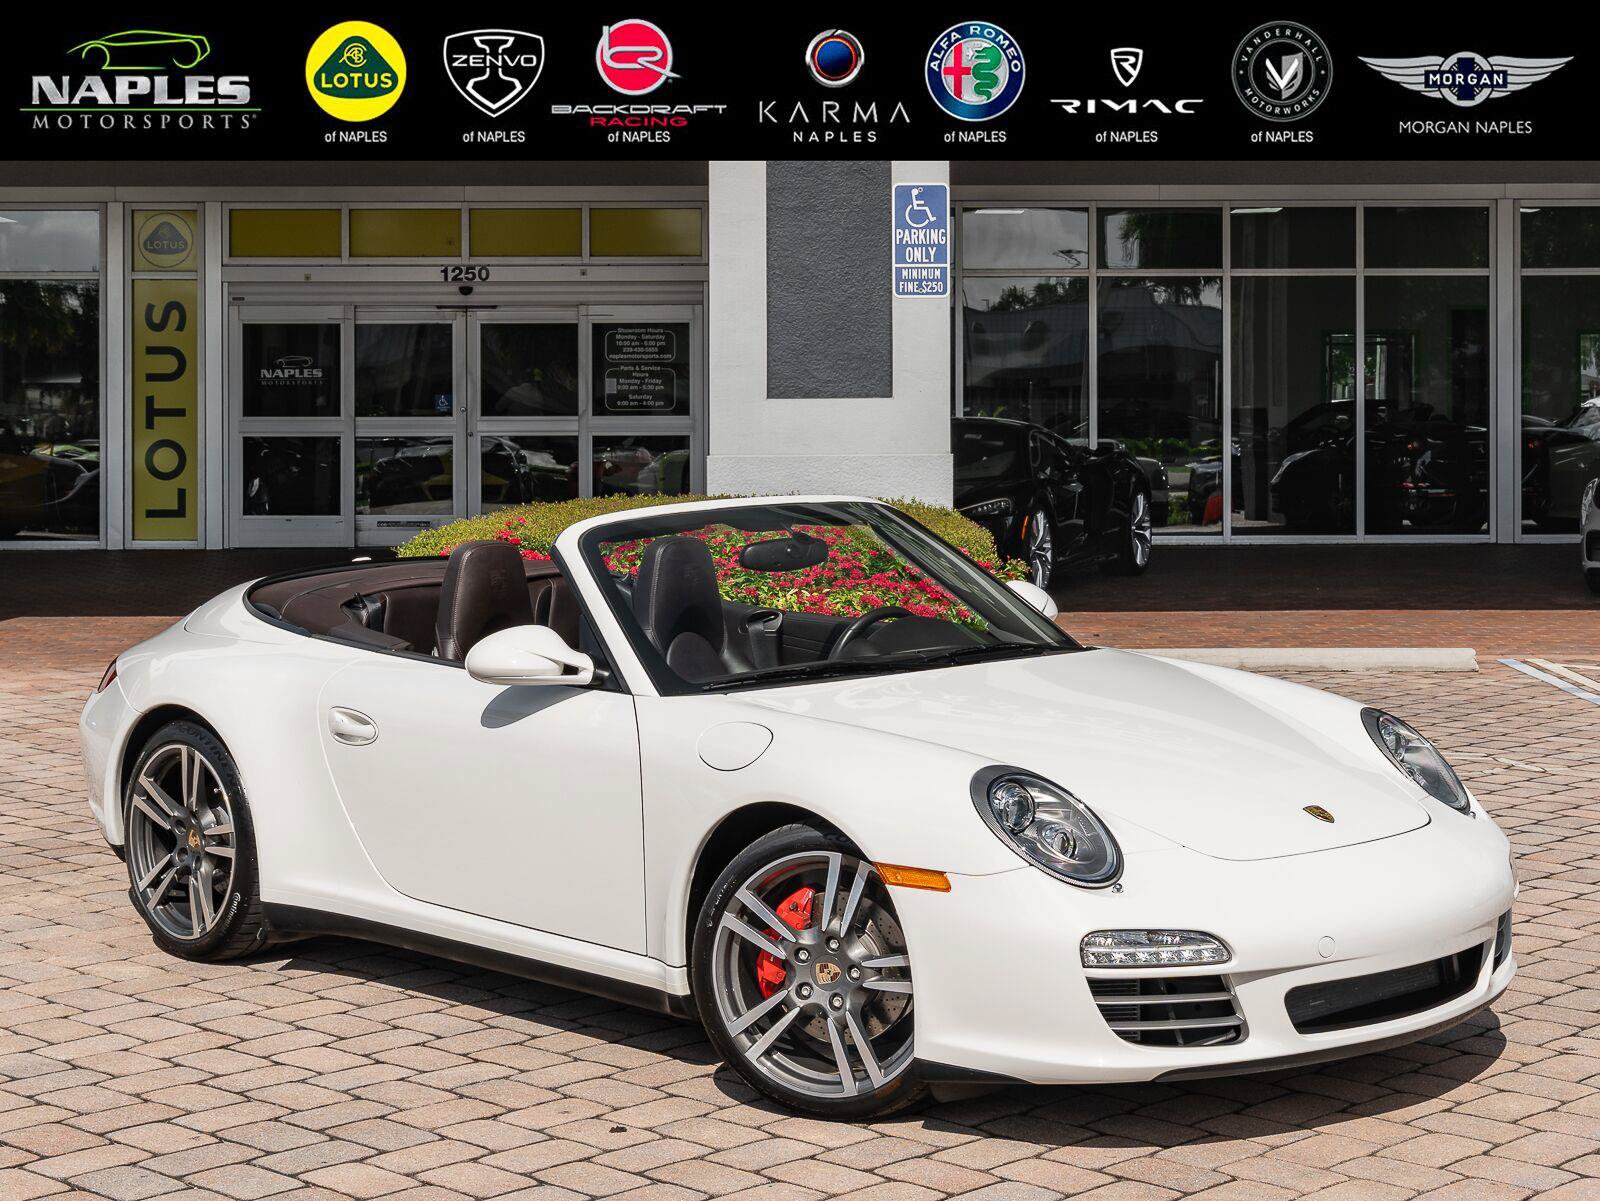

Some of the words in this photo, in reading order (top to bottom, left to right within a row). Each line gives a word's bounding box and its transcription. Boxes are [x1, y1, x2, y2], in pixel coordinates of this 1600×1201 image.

[896, 229, 946, 245] PARKING
[147, 240, 185, 249] LOTUS
[905, 247, 937, 262] ONLY
[440, 266, 490, 282] 1250
[902, 268, 941, 280] MINIMUM
[899, 281, 919, 293] FINE
[922, 280, 944, 293] $250
[260, 368, 323, 378] NAPLES
[145, 300, 187, 519] LOTUS
